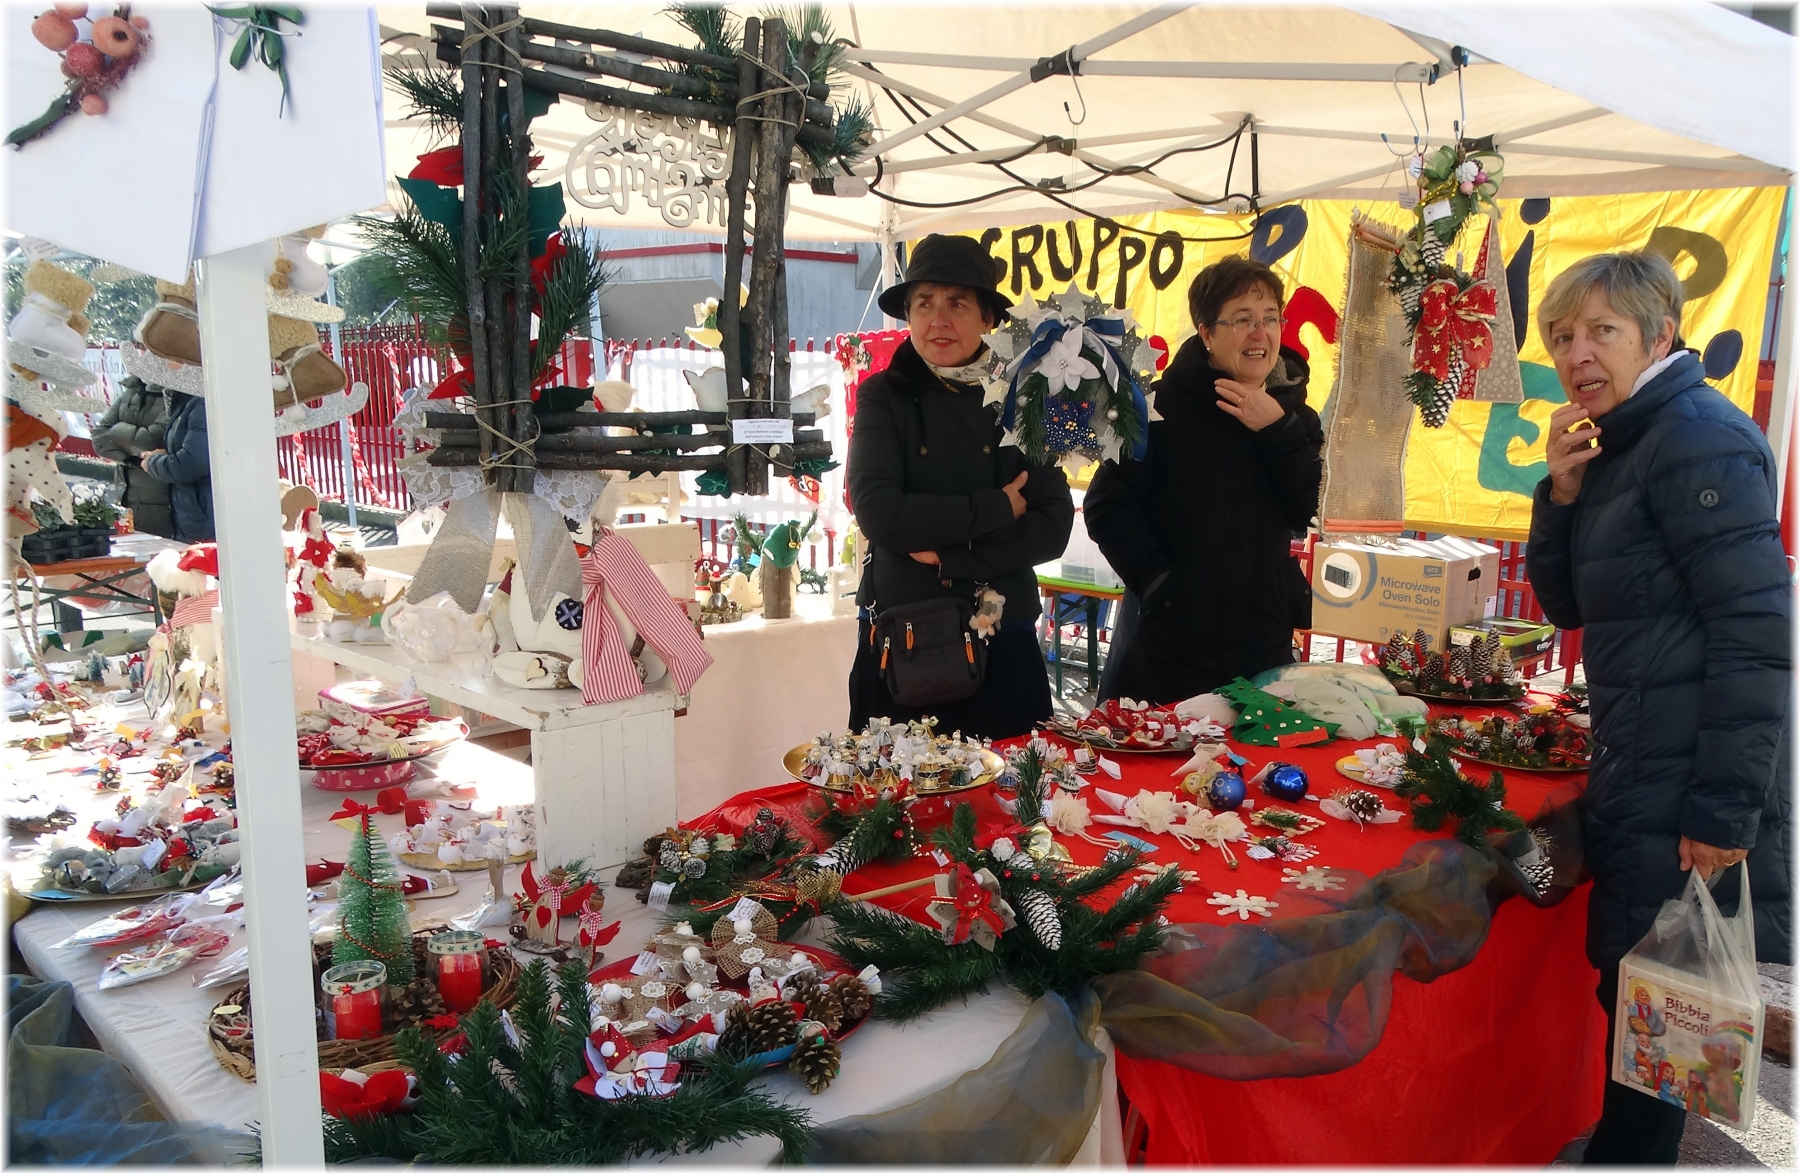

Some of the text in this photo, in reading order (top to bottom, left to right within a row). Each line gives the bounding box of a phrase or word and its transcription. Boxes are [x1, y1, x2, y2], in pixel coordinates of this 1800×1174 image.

[1381, 576, 1441, 594] Microwave
[1383, 589, 1440, 607] Oven Solo
[1665, 997, 1710, 1022] Bibbia
[1664, 1012, 1709, 1036] Piccoli
